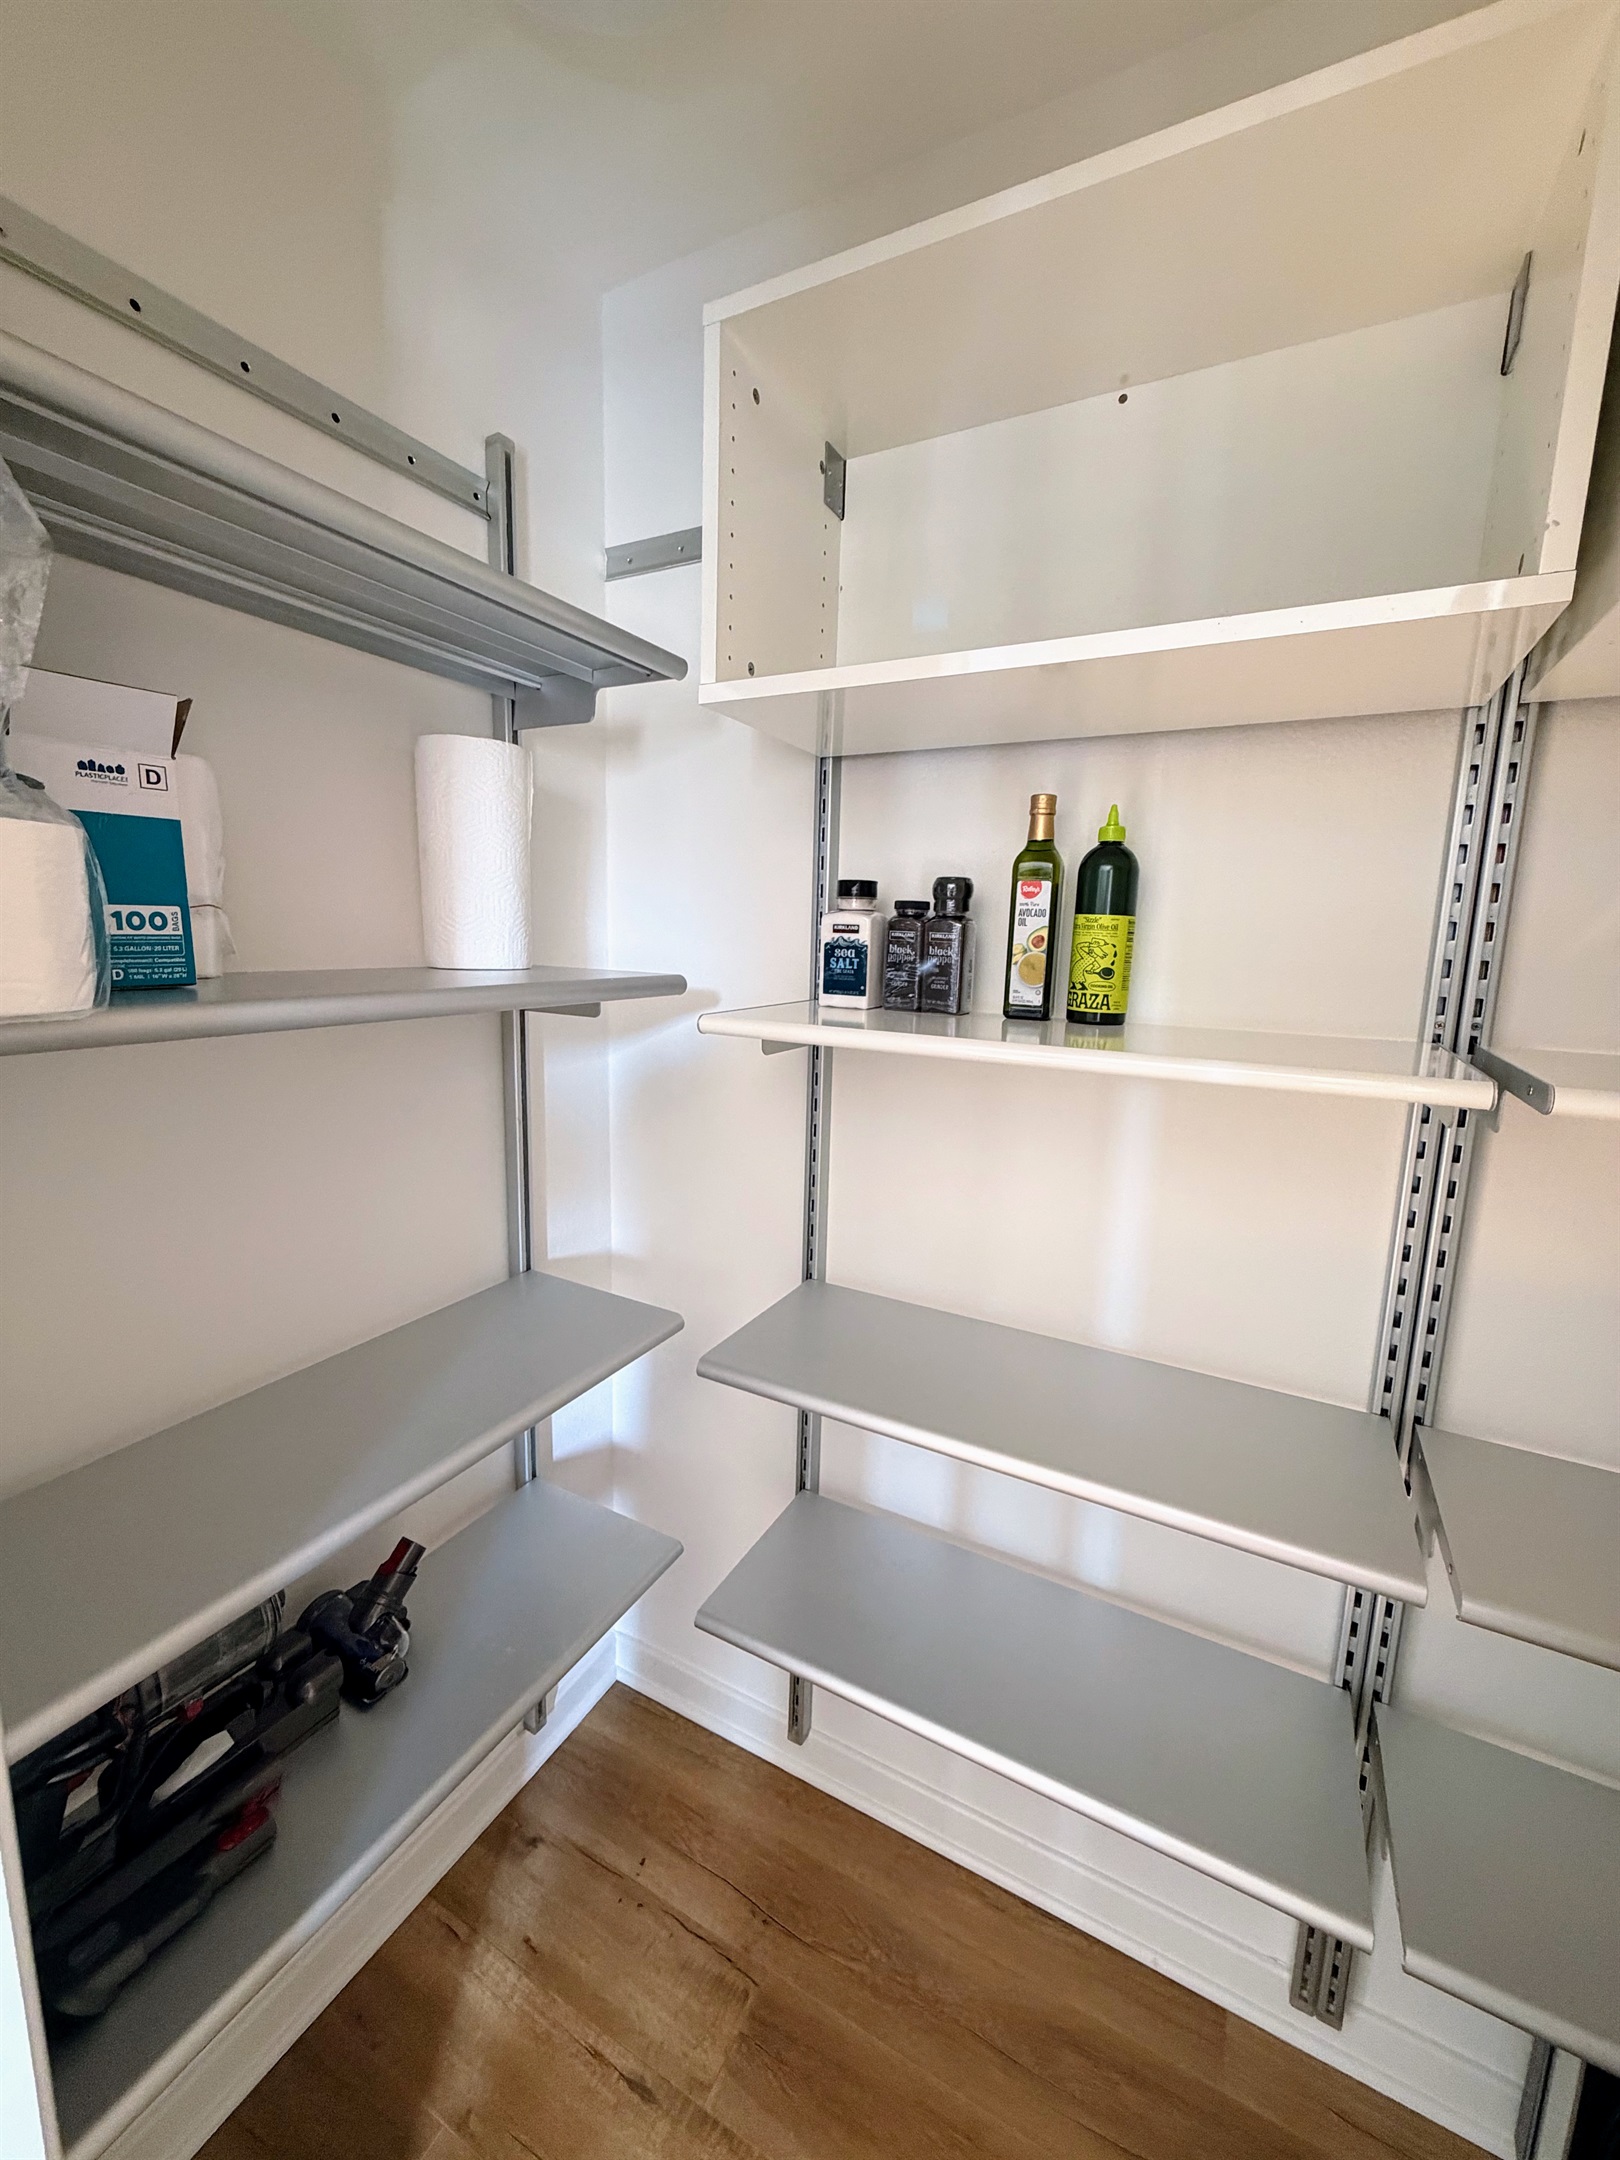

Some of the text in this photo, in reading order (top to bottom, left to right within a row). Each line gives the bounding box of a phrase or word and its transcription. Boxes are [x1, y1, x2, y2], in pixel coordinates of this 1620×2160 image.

[145, 768, 161, 785] D
[1018, 908, 1047, 918] AVOCADO
[110, 910, 168, 931] 100
[171, 911, 180, 932] BAGS
[1018, 918, 1028, 927] OIL
[1110, 923, 1119, 931] Oil
[834, 948, 856, 958] sea
[889, 943, 913, 955] black
[929, 945, 953, 957] black
[829, 957, 860, 969] SALT
[111, 968, 124, 981] D
[1067, 991, 1111, 1011] GRAZA
